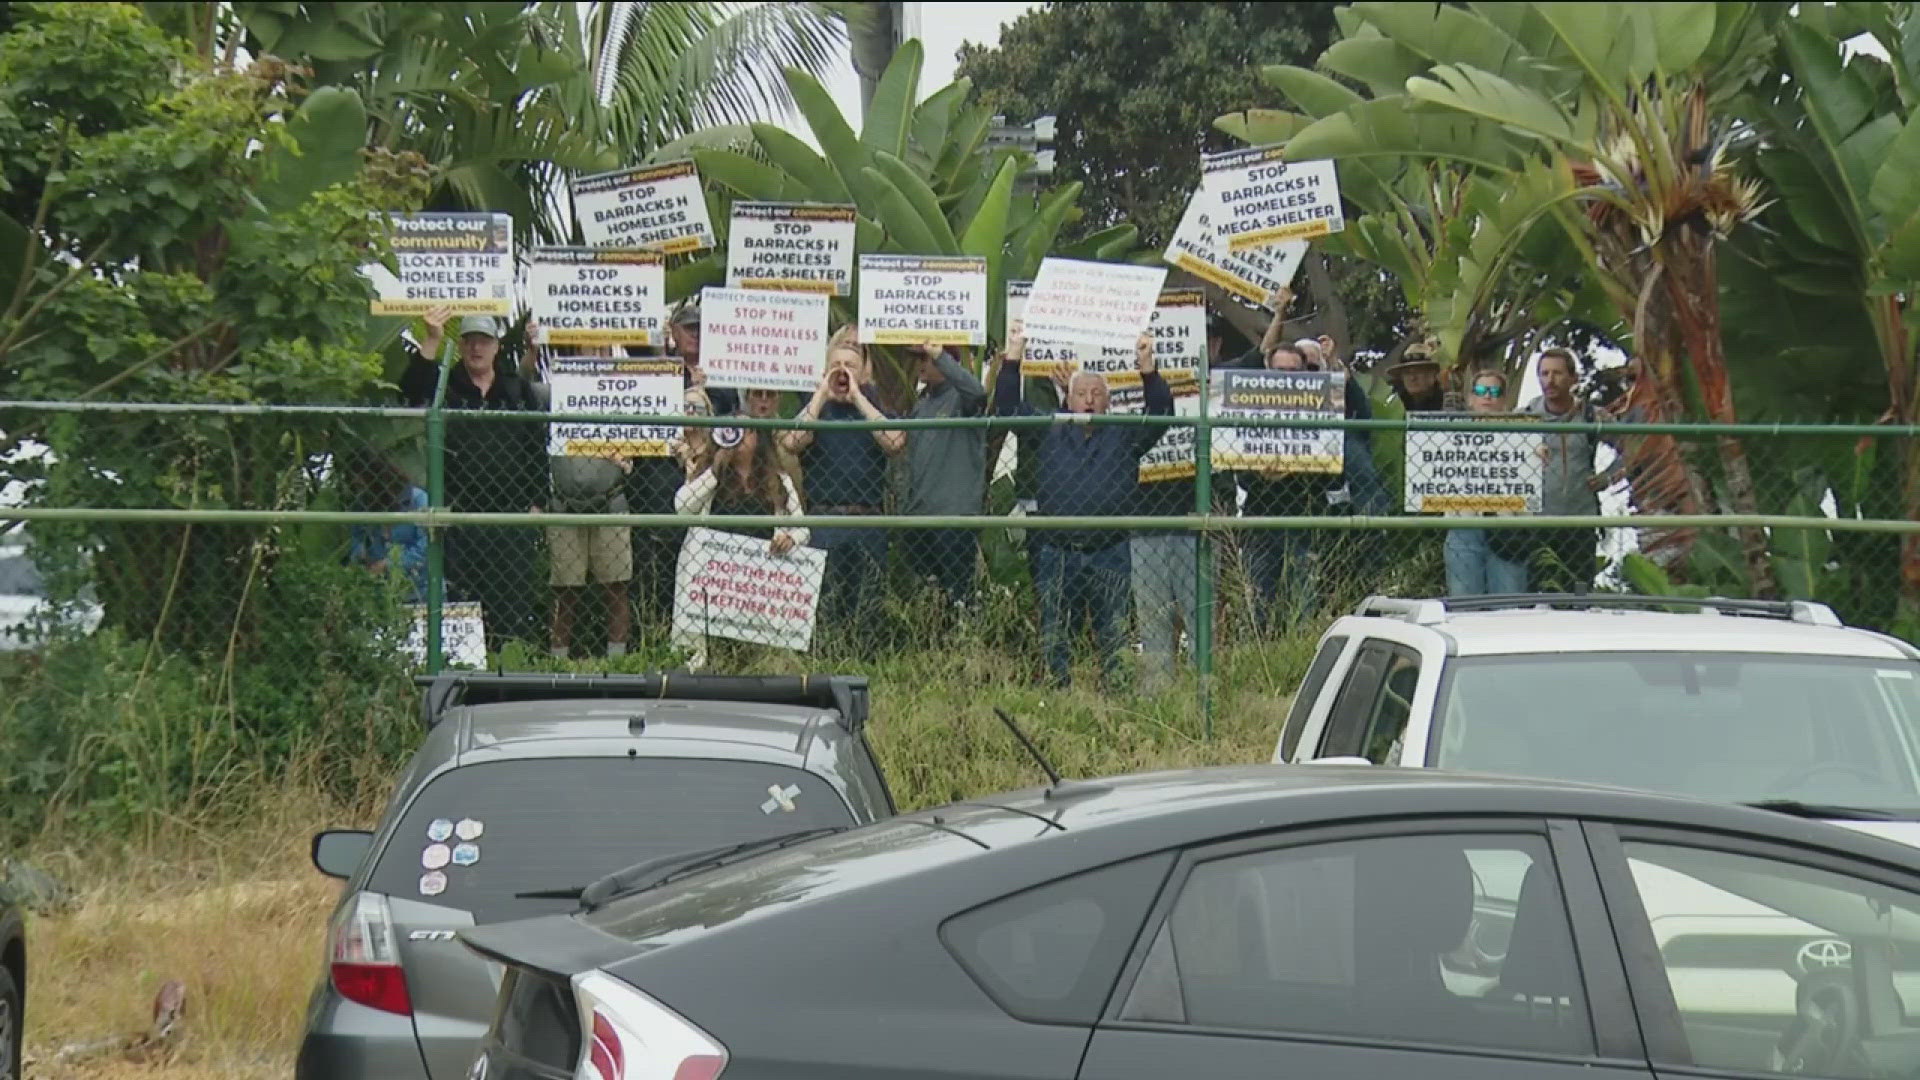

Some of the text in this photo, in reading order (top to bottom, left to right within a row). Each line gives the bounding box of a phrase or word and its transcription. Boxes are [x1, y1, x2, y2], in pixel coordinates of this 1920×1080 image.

[1248, 165, 1287, 182] STOP
[618, 186, 656, 203] STOP
[1221, 175, 1320, 203] BARRACKS H
[594, 196, 688, 223] BARRACKS H
[1233, 192, 1317, 217] HOMELESS
[391, 217, 487, 231] Protect our
[607, 211, 686, 235] HOMELESS
[1217, 205, 1334, 236] MEGA-SHELTER
[773, 223, 812, 235] STOP
[390, 234, 487, 251] community
[744, 238, 838, 251] BARRACKS H
[396, 256, 500, 268] LOCATE THE
[752, 253, 831, 266] HOMELESS
[400, 271, 485, 283] HOMELESS
[578, 268, 618, 280] STOP
[732, 266, 846, 280] MEGA-SHELTER
[903, 275, 942, 286] STOP
[406, 287, 478, 299] SHELTER
[548, 284, 648, 296] BARRACKS H
[874, 289, 970, 300] BARRACKS H
[557, 301, 641, 313] HOMELESS
[884, 303, 964, 315] HOMELESS
[735, 307, 795, 321] STOP THE
[538, 316, 657, 329] MEGA-SHELTER
[865, 318, 979, 330] MEGA-SHELTER
[708, 323, 819, 341] MEGA HOMELESS
[726, 342, 799, 357] SHELTER AT
[708, 359, 815, 376] KETTNER & VINE
[597, 379, 638, 392] STOP
[1232, 374, 1324, 390] Protect our
[567, 395, 667, 407] BARRACKS H
[1230, 393, 1324, 409] community
[1236, 427, 1320, 440] HOMELESS
[1453, 434, 1495, 446] STOP
[1244, 443, 1312, 455] SHELTER
[1423, 450, 1526, 462] BARRACKS H
[1432, 467, 1518, 479] HOMELESS
[1412, 483, 1535, 495] MEGA-SHELTER
[707, 559, 804, 586] STOP THE MEGA
[692, 575, 813, 605] HOMELESS SHELTER
[710, 593, 767, 613] KETTNER
[781, 606, 808, 620] VINE
